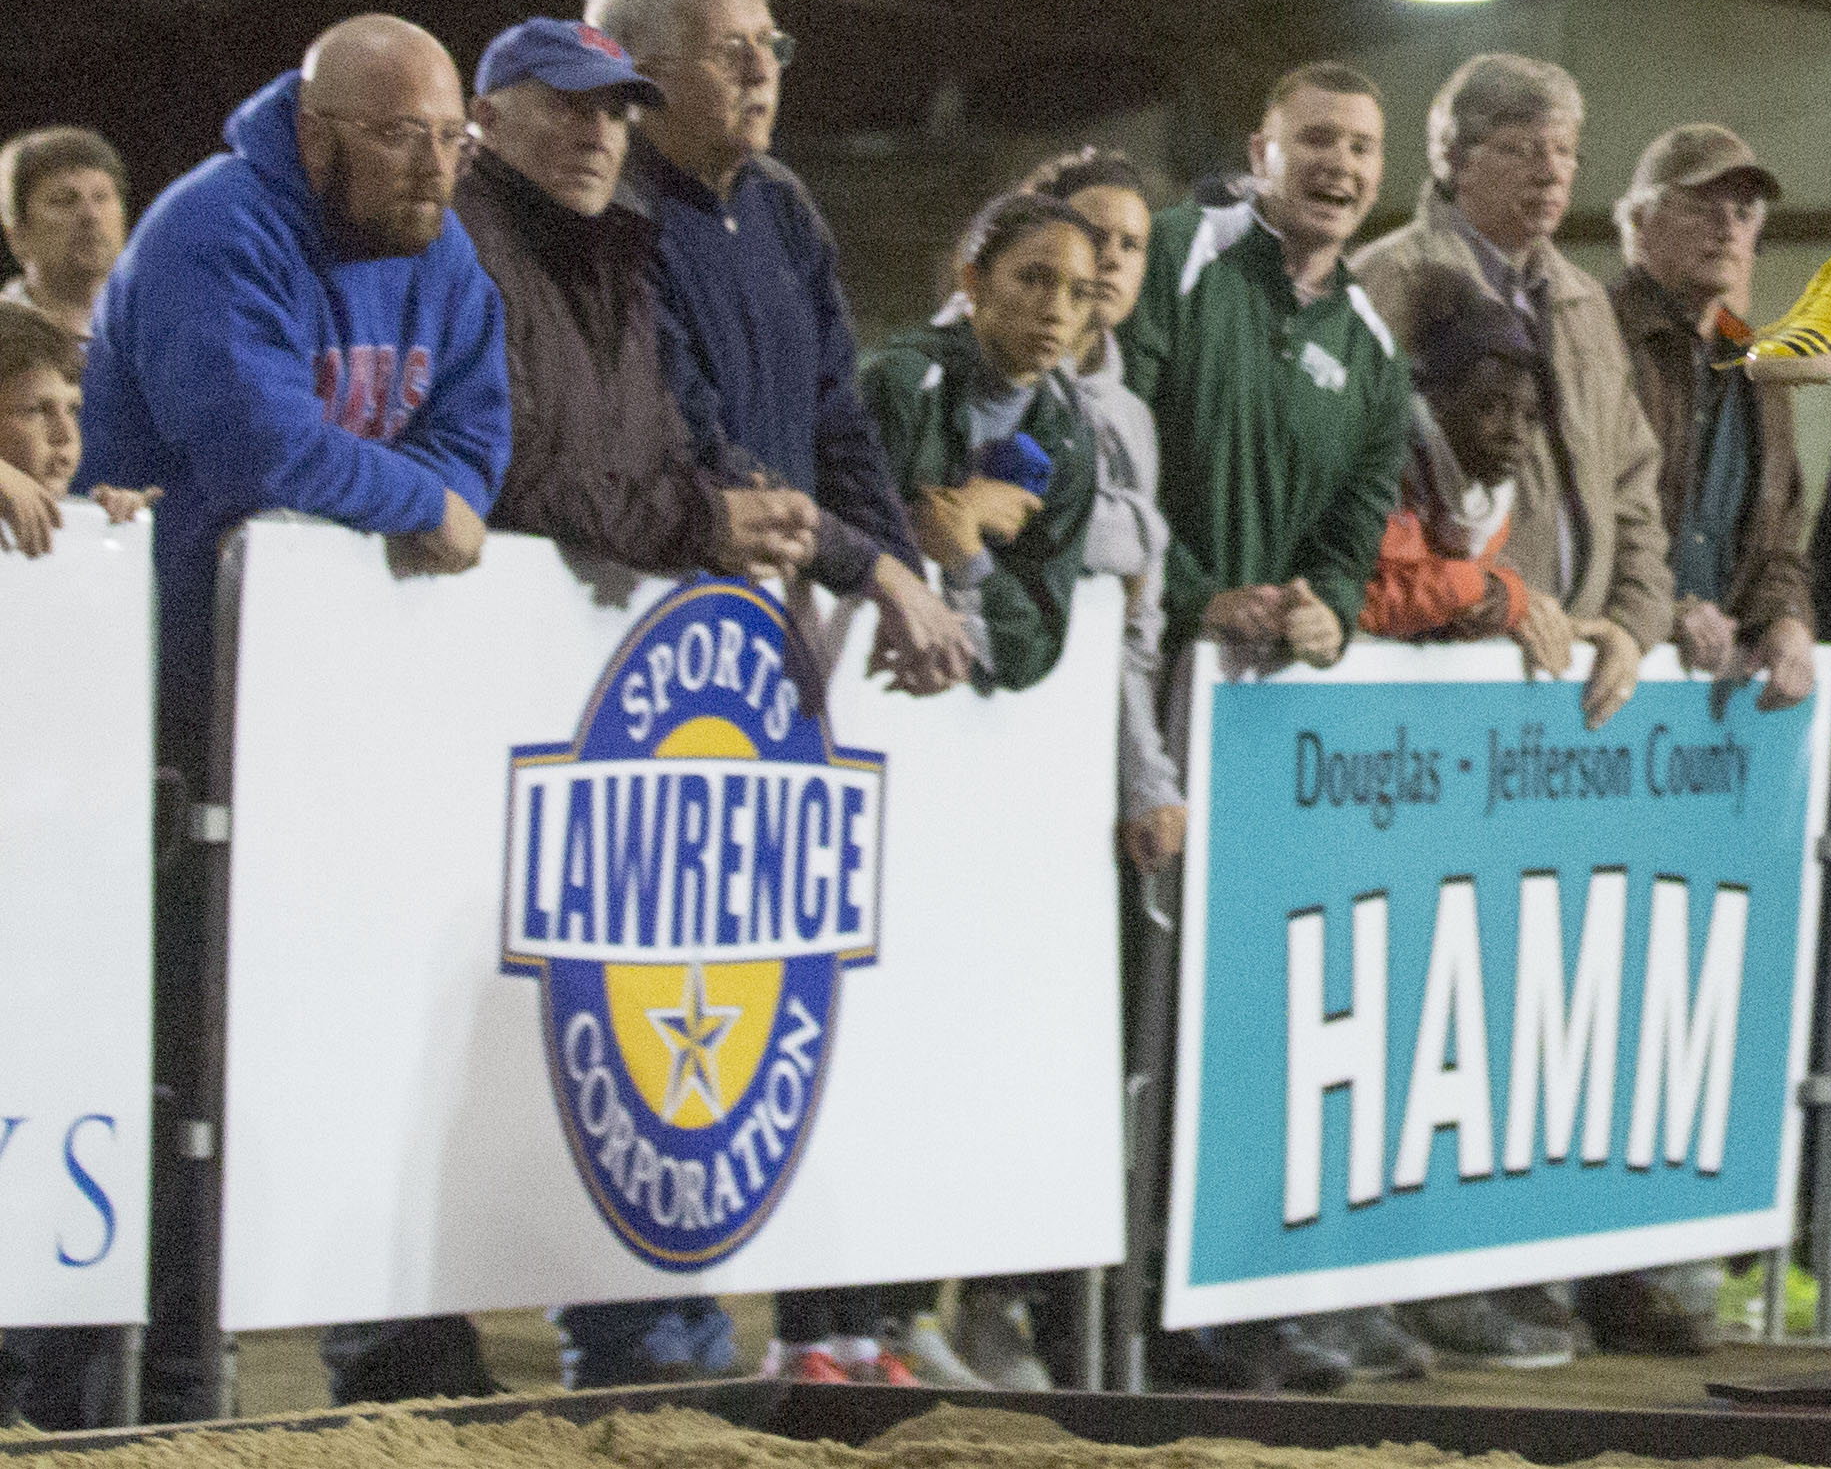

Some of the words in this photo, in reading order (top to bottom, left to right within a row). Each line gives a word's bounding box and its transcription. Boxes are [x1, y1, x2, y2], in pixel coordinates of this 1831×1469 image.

[619, 620, 799, 741] SPORTS
[522, 772, 867, 950] LAWRENCE
[1296, 725, 1441, 830] Douglas
[1483, 723, 1632, 818] Jefferson
[1646, 724, 1750, 817] County
[563, 999, 824, 1230] CORPORATION
[1283, 865, 1750, 1230] HAMM
